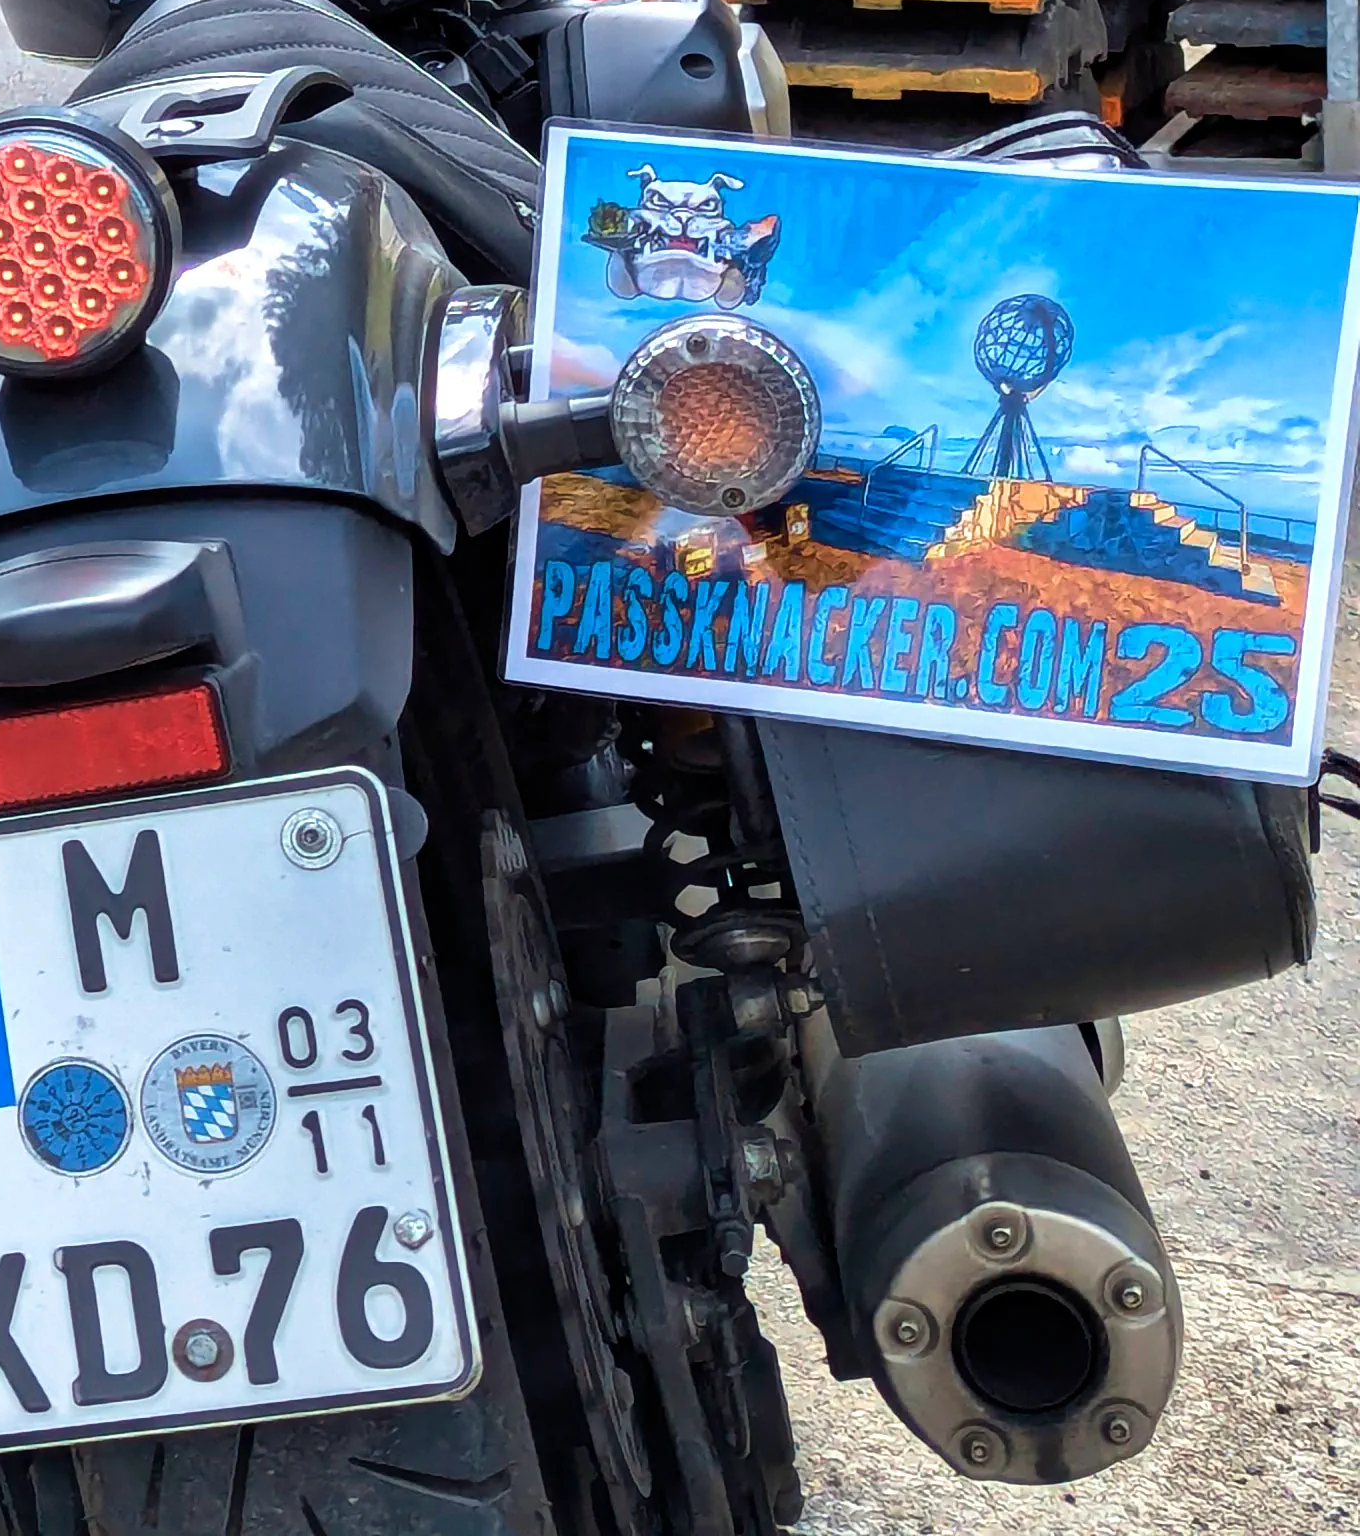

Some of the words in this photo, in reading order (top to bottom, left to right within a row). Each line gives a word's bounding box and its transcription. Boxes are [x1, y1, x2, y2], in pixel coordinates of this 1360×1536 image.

[533, 558, 1108, 718] PASSKNACKER.COM
[1108, 621, 1297, 734] 25
[61, 828, 181, 994] M
[277, 997, 375, 1069] 03
[301, 1104, 386, 1175] 11
[208, 1204, 435, 1388] 76
